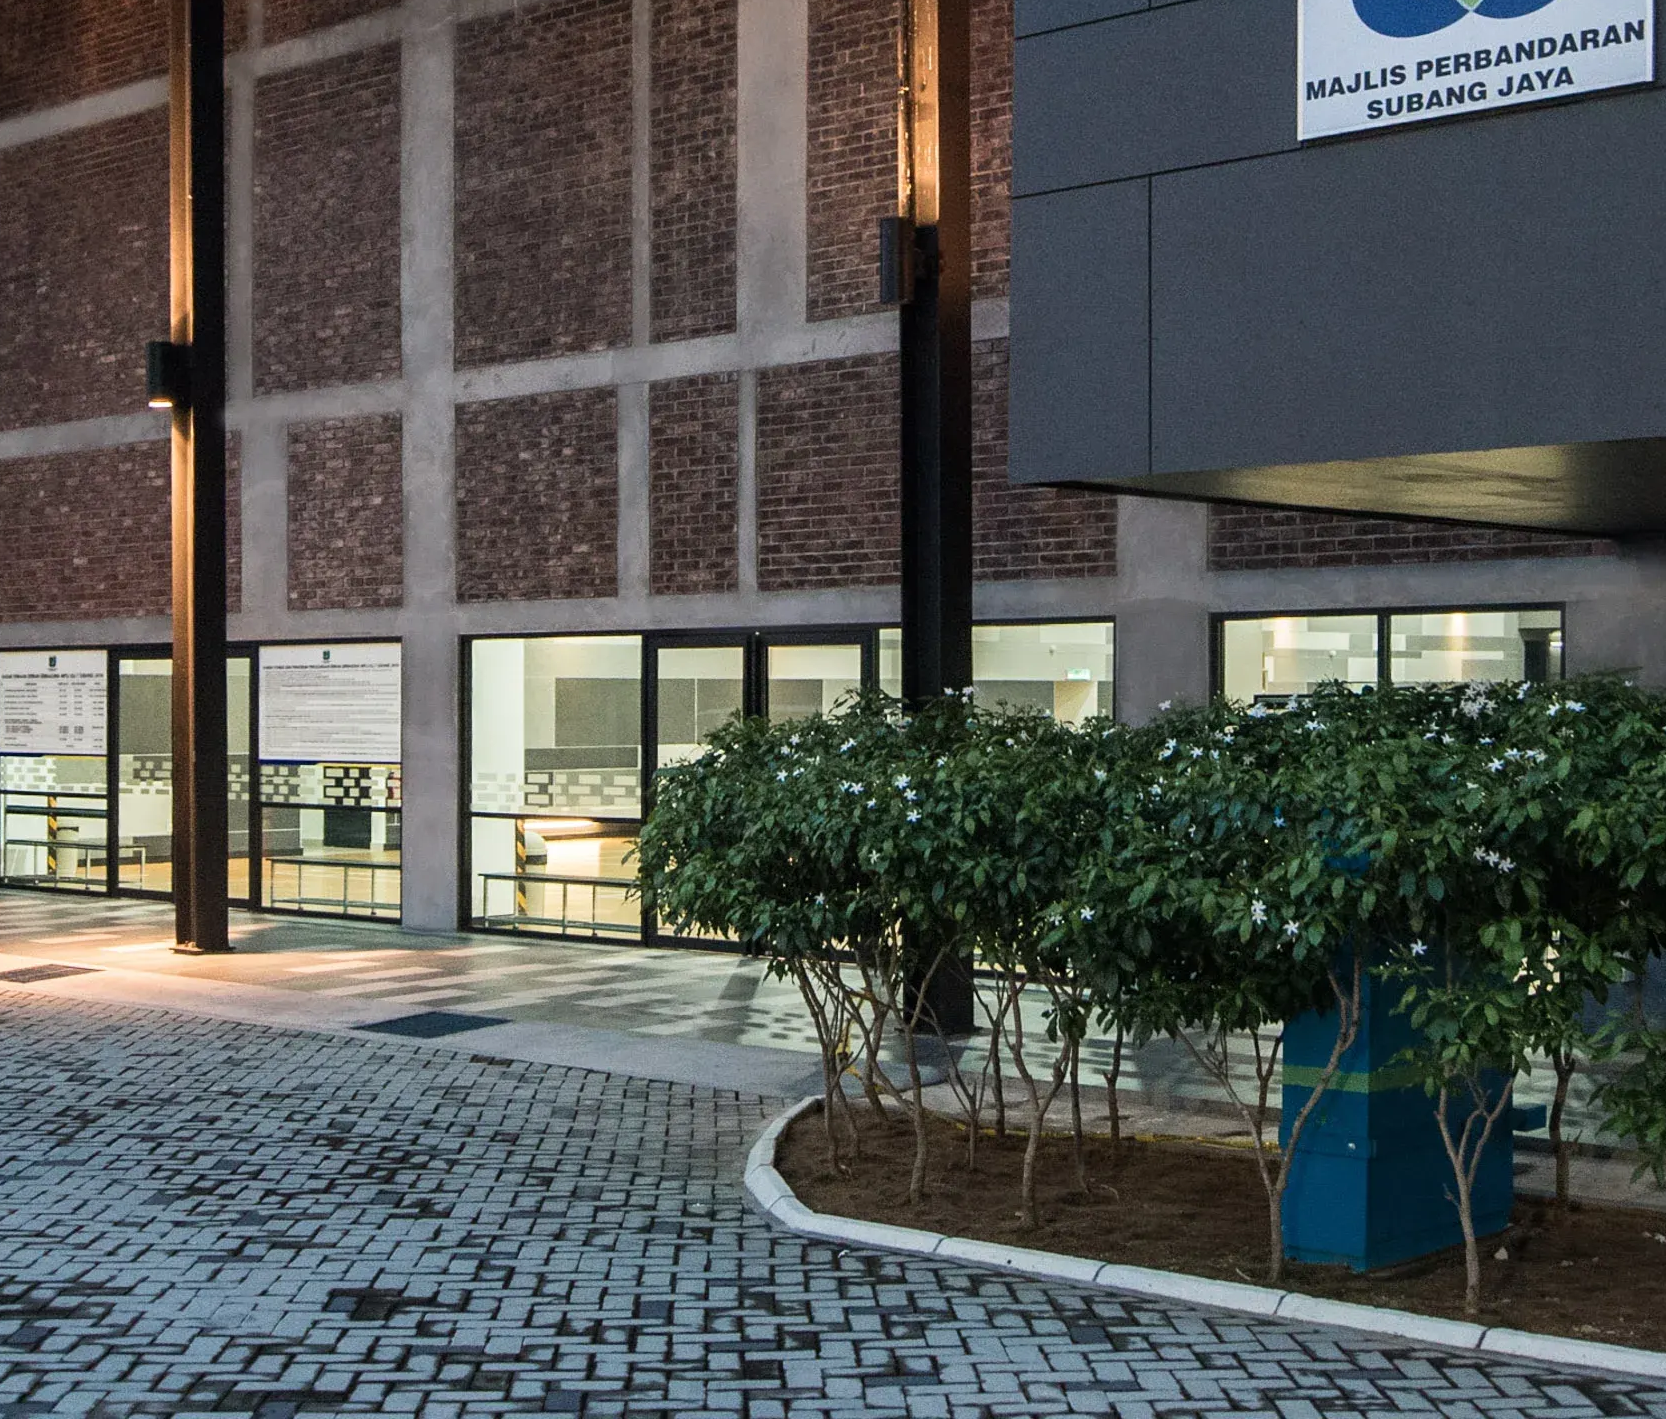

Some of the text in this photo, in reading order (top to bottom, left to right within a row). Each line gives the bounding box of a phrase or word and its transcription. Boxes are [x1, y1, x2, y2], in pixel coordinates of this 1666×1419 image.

[1306, 19, 1645, 101] MAJLIS PERBANDARAN
[1366, 66, 1574, 120] SUBANG JAYA
